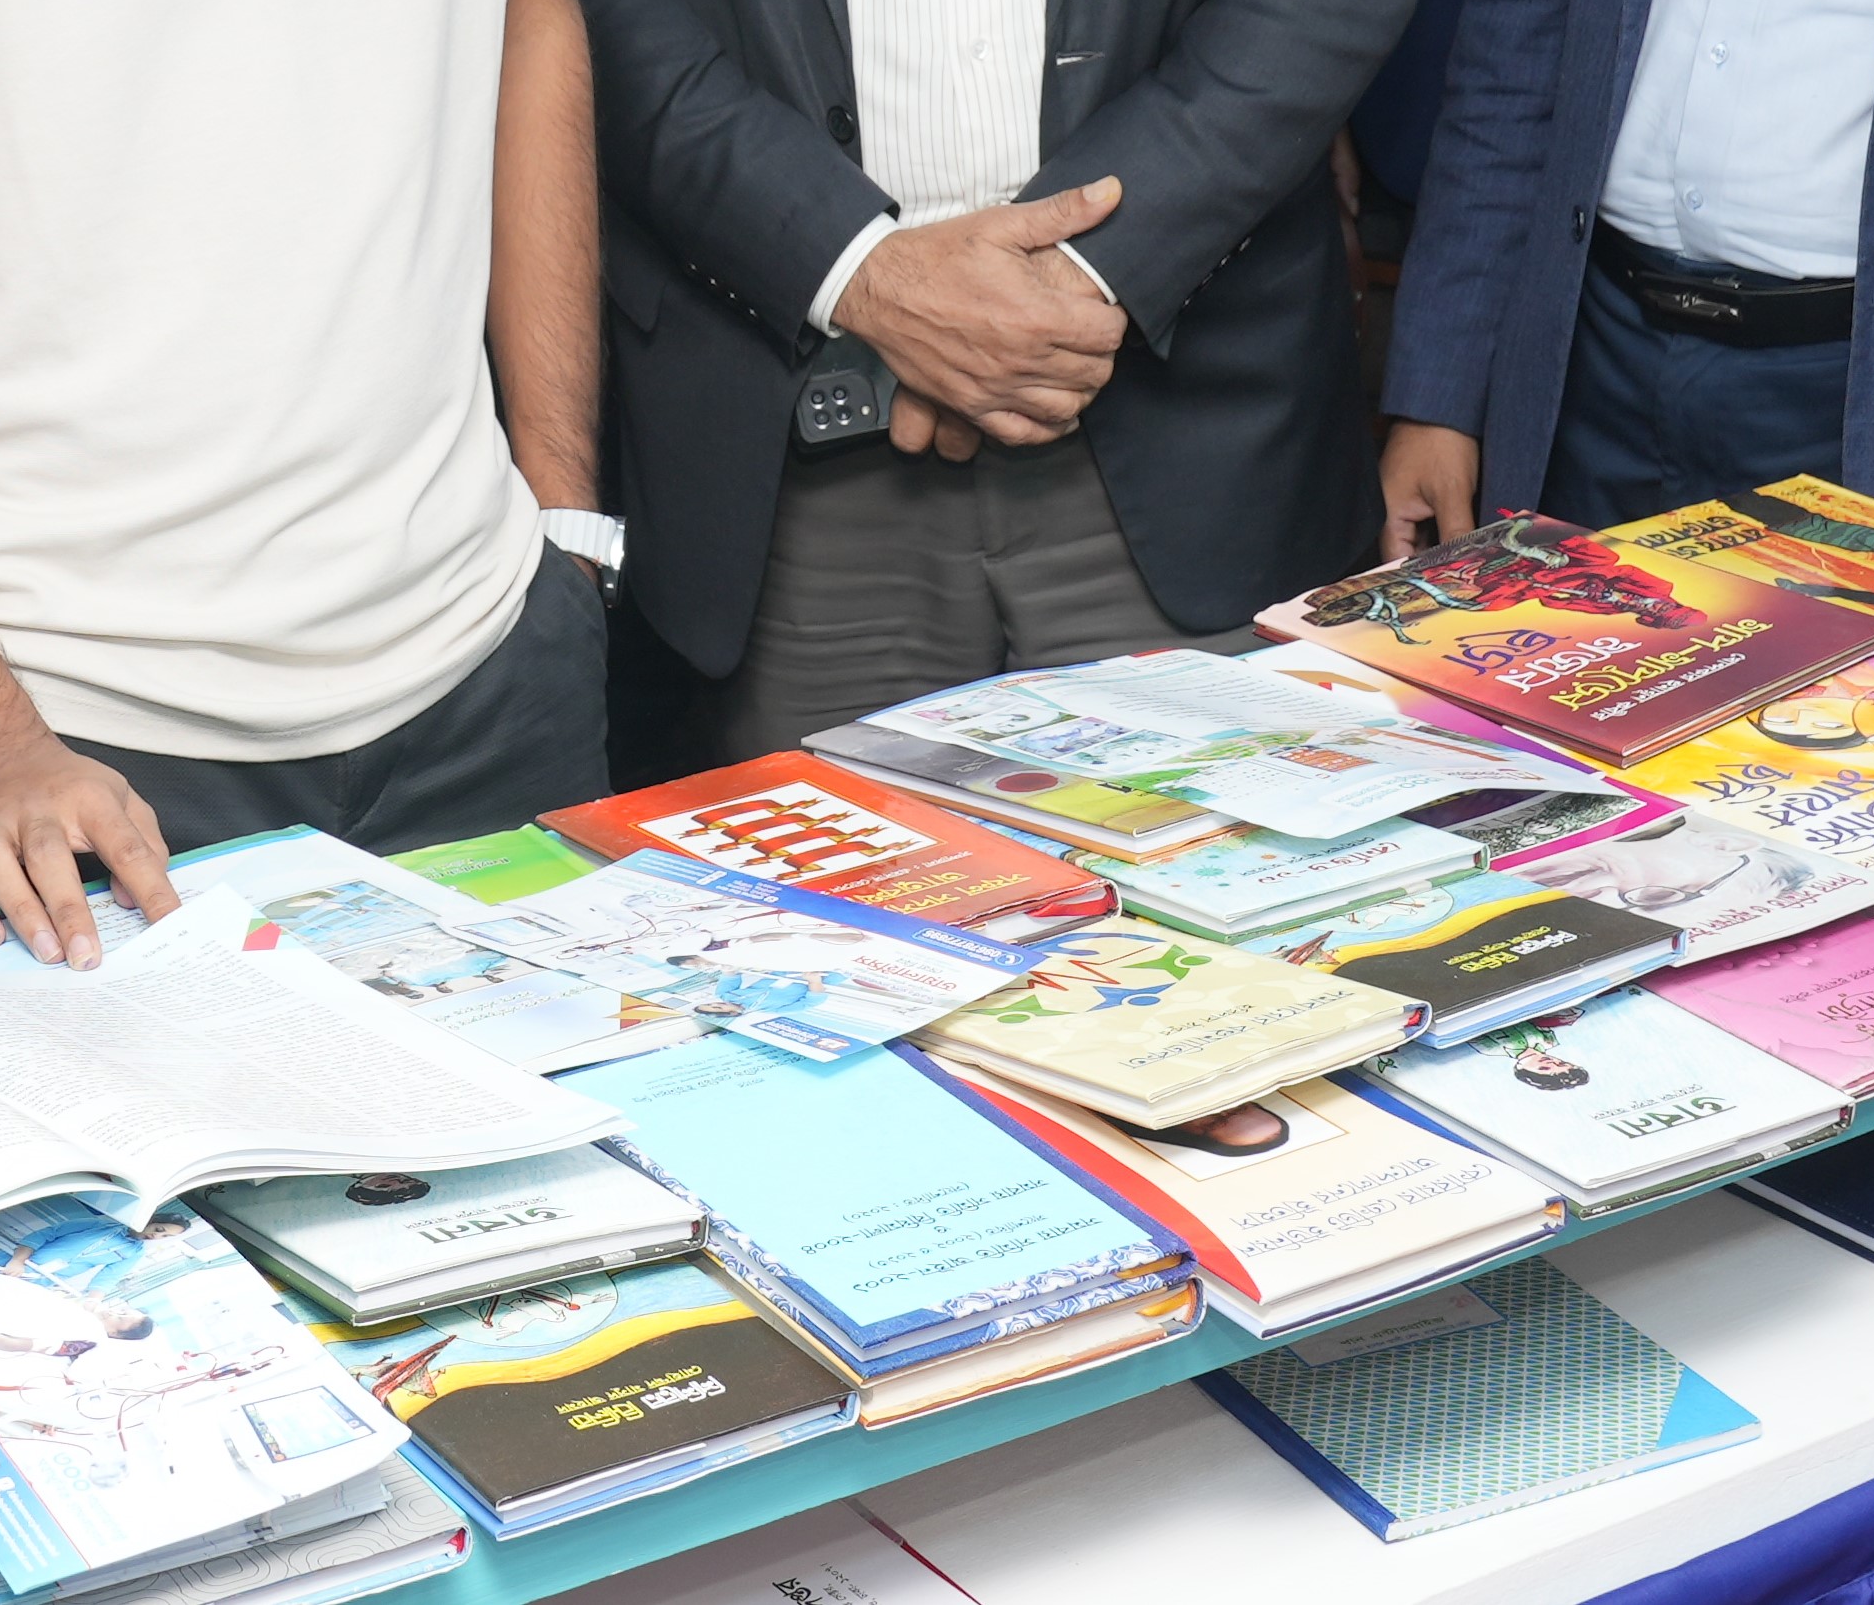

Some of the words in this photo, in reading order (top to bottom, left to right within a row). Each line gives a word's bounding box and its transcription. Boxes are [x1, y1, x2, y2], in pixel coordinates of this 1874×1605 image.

[1441, 629, 1572, 677] ছড়া
[1494, 636, 1642, 694] মজার
[1690, 763, 1793, 804] ছবি
[955, 874, 1032, 896] সফল
[989, 1178, 1050, 1201] সমবায়
[1311, 1157, 1441, 1205] আন্দোলনের
[1395, 1164, 1493, 1206] কোরিয়ার
[936, 1197, 989, 1218] সমিতি
[1229, 1199, 1318, 1231] ইতিহাস
[1327, 1198, 1397, 1232] ক্রেডিট
[933, 1225, 948, 1235] ও
[1035, 1216, 1103, 1241] সমবায়
[1233, 1224, 1333, 1258] ইউনিয়ন
[975, 1237, 1036, 1260] সমিতি
[639, 1375, 726, 1410] শিশিরের
